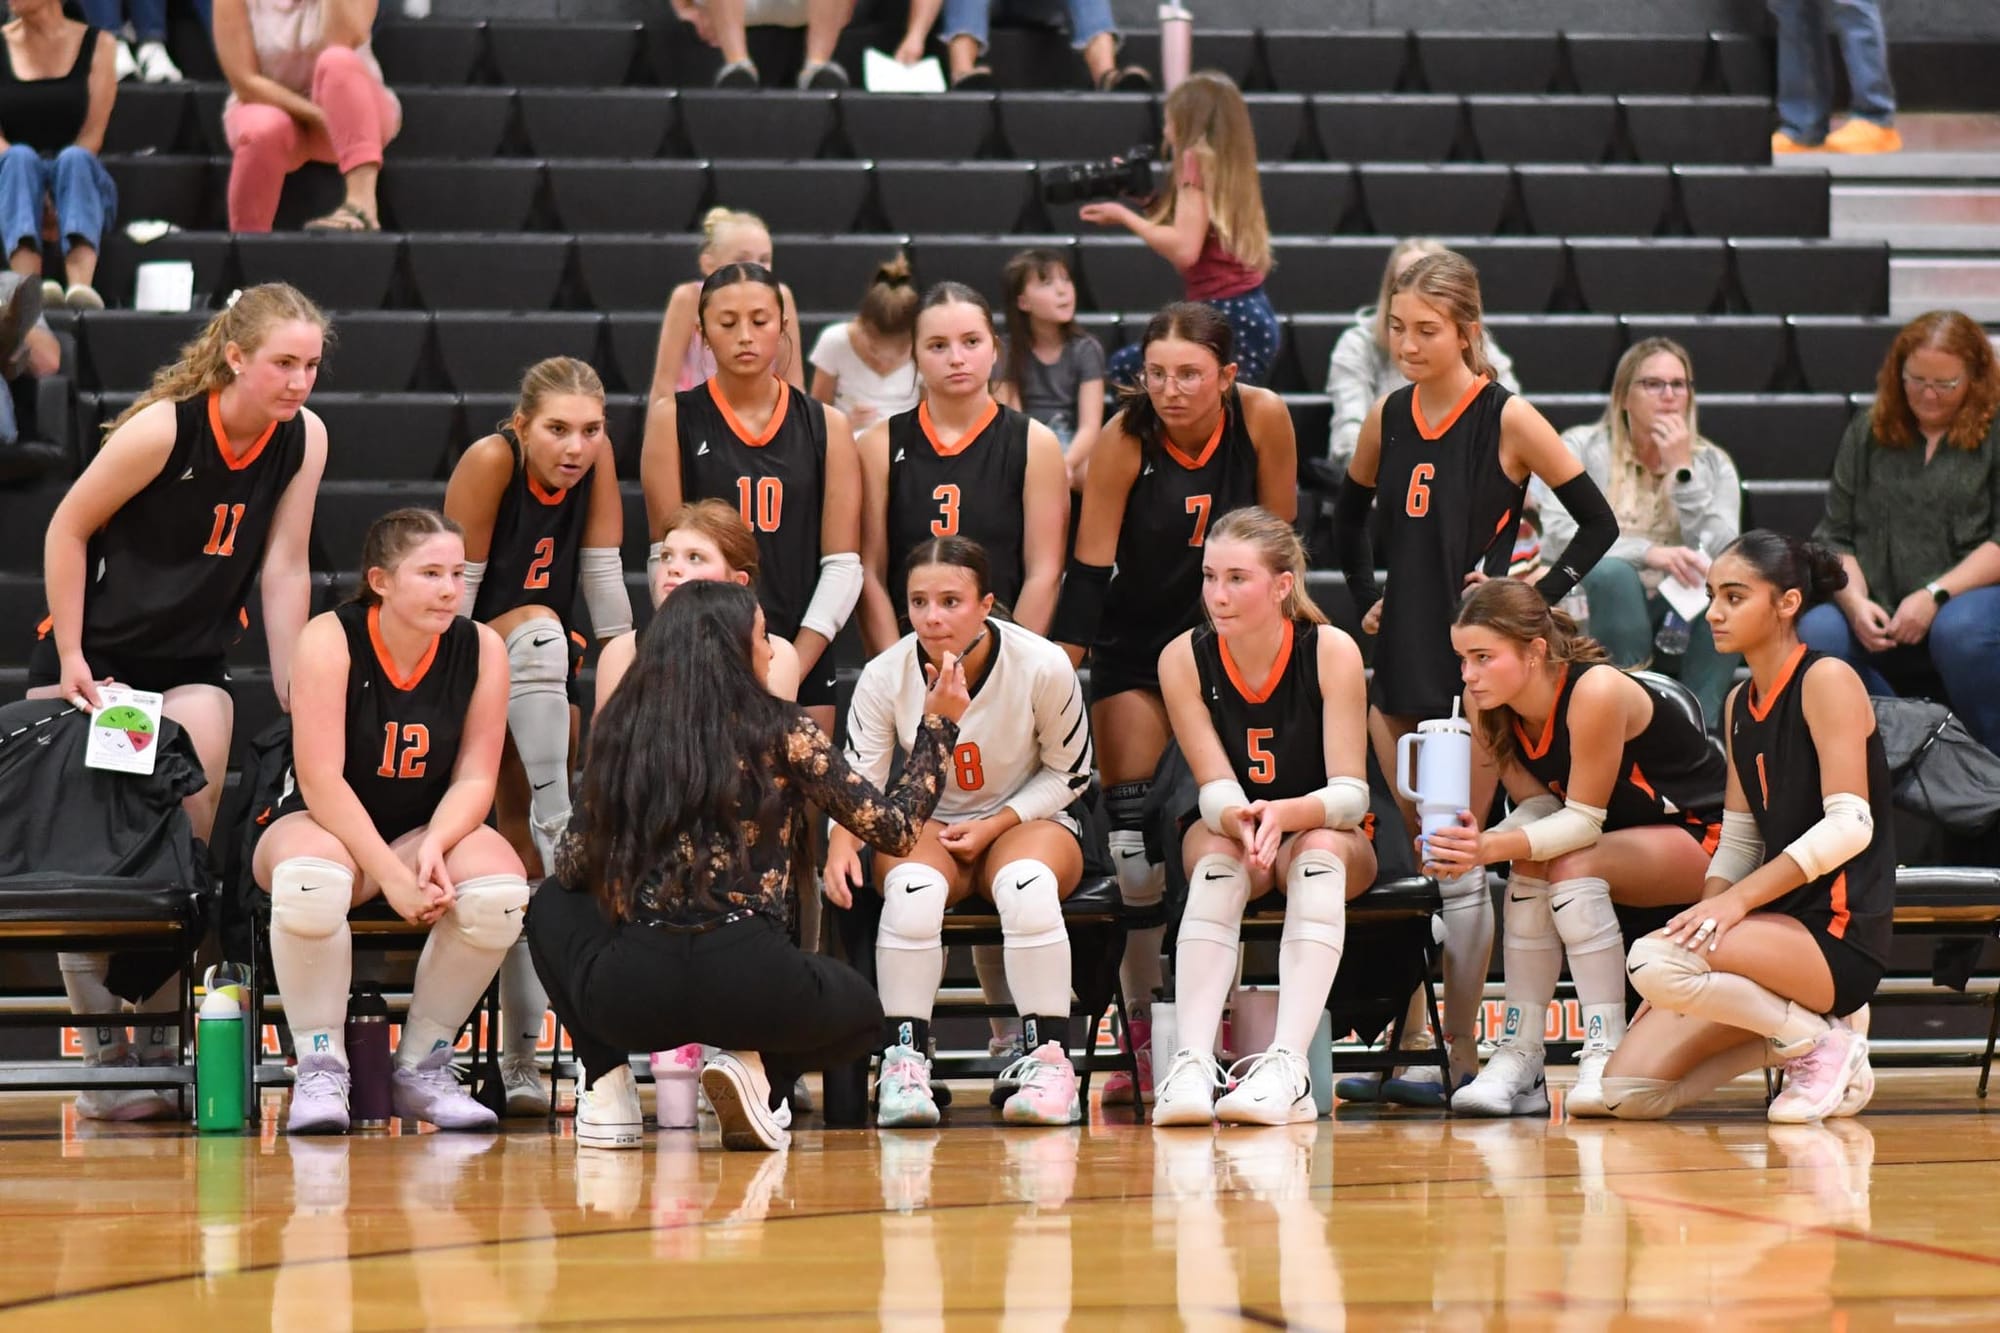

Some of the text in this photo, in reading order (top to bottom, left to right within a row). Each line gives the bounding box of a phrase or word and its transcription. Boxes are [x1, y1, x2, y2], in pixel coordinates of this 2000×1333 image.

[736, 476, 783, 532] 10
[931, 484, 960, 538] 3
[1406, 463, 1435, 517] 6
[203, 504, 245, 557] 11
[1185, 494, 1212, 547] 7
[524, 538, 554, 589] 2
[377, 722, 429, 778] 12
[953, 741, 984, 791] 8
[1247, 728, 1275, 783] 5
[1756, 753, 1769, 811] 1
